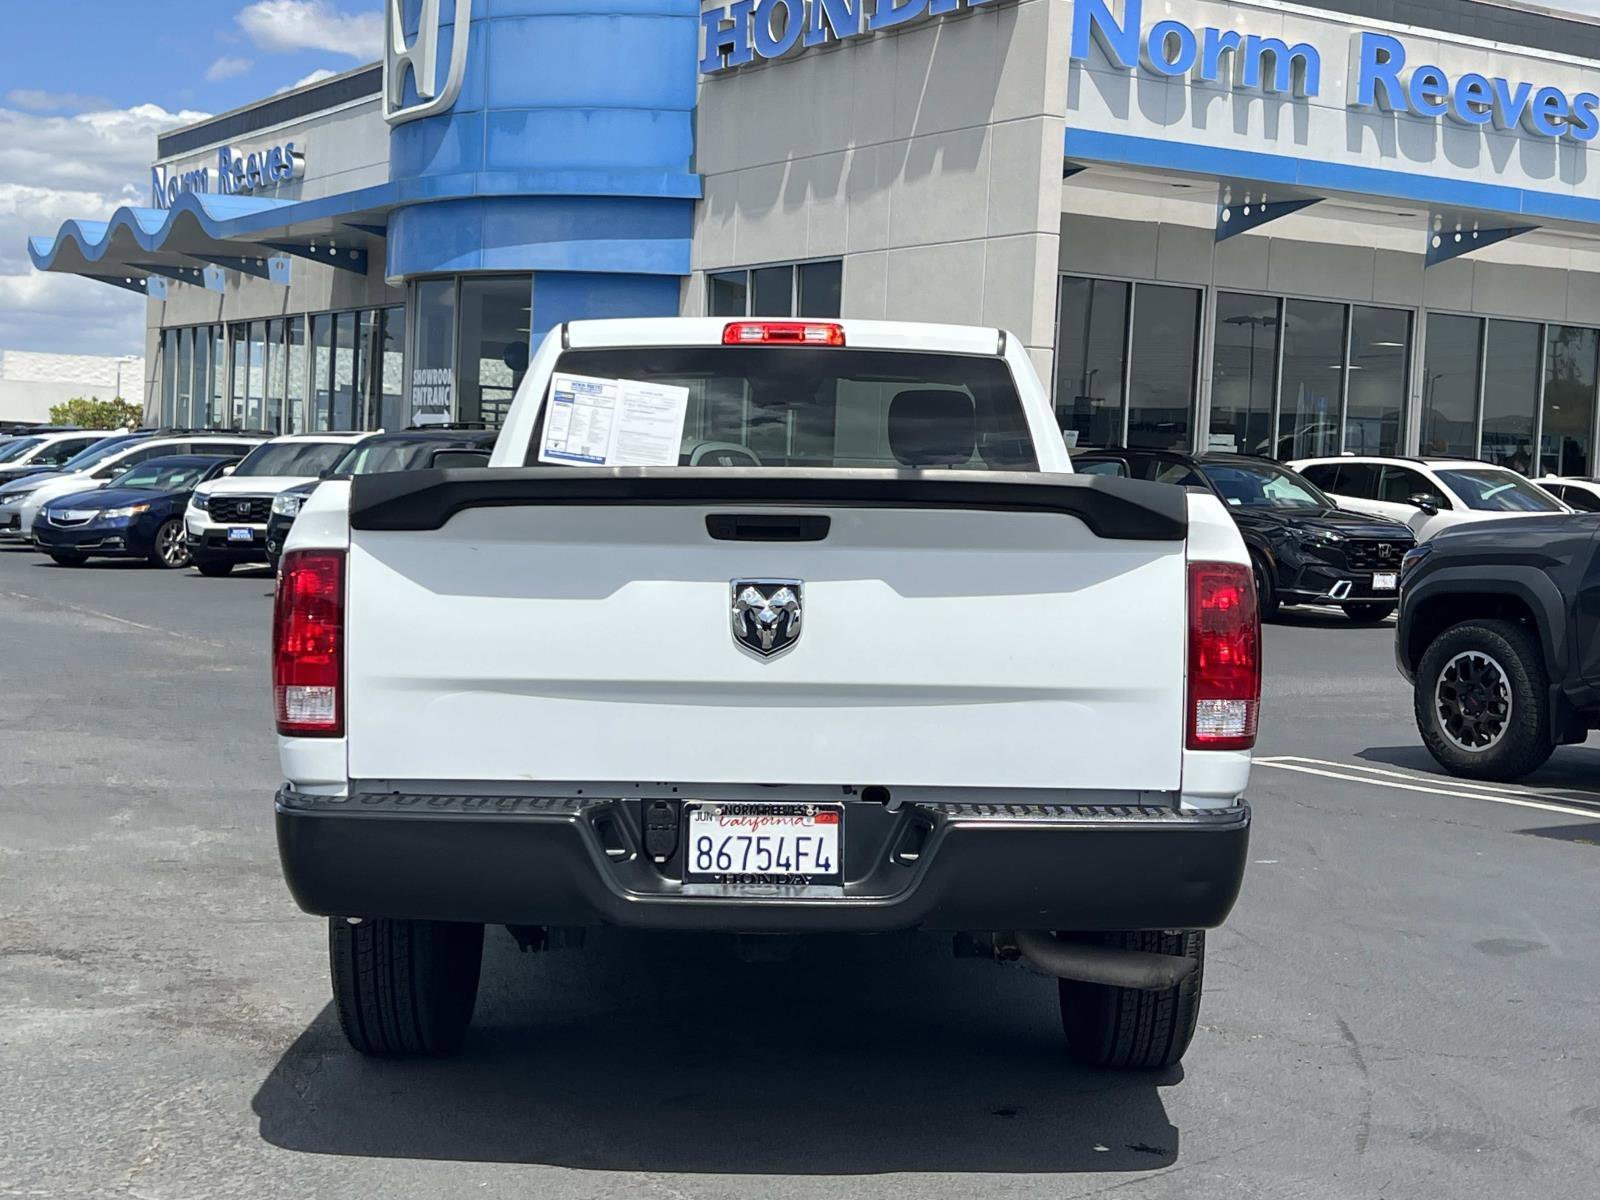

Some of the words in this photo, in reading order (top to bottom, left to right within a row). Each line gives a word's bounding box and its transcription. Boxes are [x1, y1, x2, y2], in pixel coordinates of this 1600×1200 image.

[701, 0, 998, 74] HON
[1070, 0, 1321, 97] Norm
[1356, 31, 1600, 142] Reeves
[218, 141, 297, 194] Reeves
[412, 386, 449, 406] ENTRANC
[695, 811, 713, 823] JUN
[696, 835, 832, 873] 86754F4
